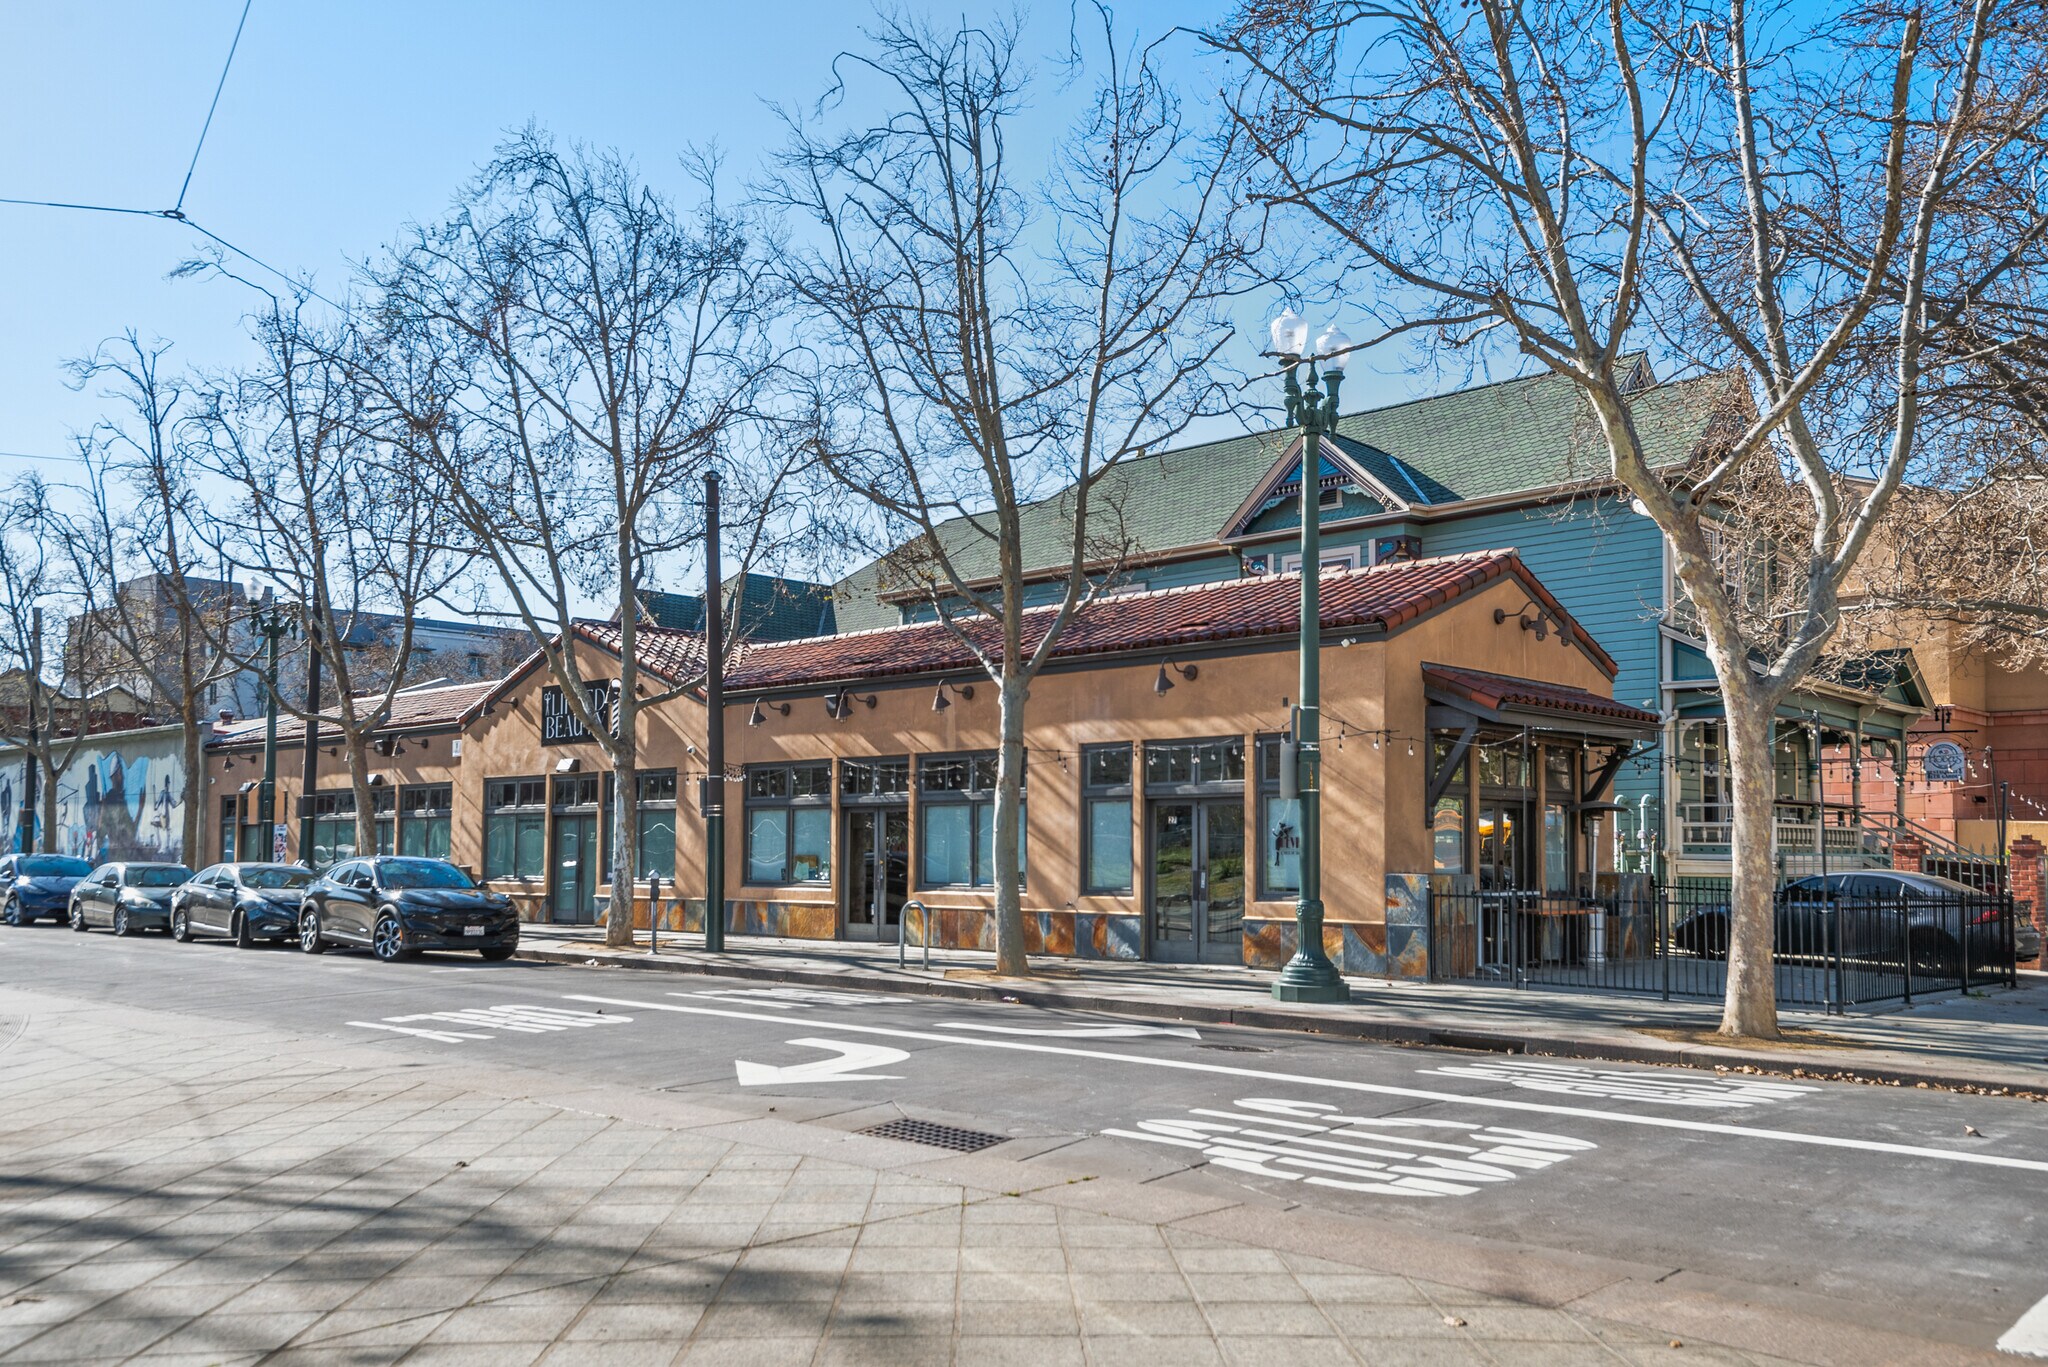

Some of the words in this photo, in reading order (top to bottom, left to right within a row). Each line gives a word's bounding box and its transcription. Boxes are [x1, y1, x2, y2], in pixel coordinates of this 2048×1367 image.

[344, 1004, 634, 1043] ONLY
[1415, 1061, 1823, 1108] STOP
[1099, 1097, 1599, 1197] STOP
